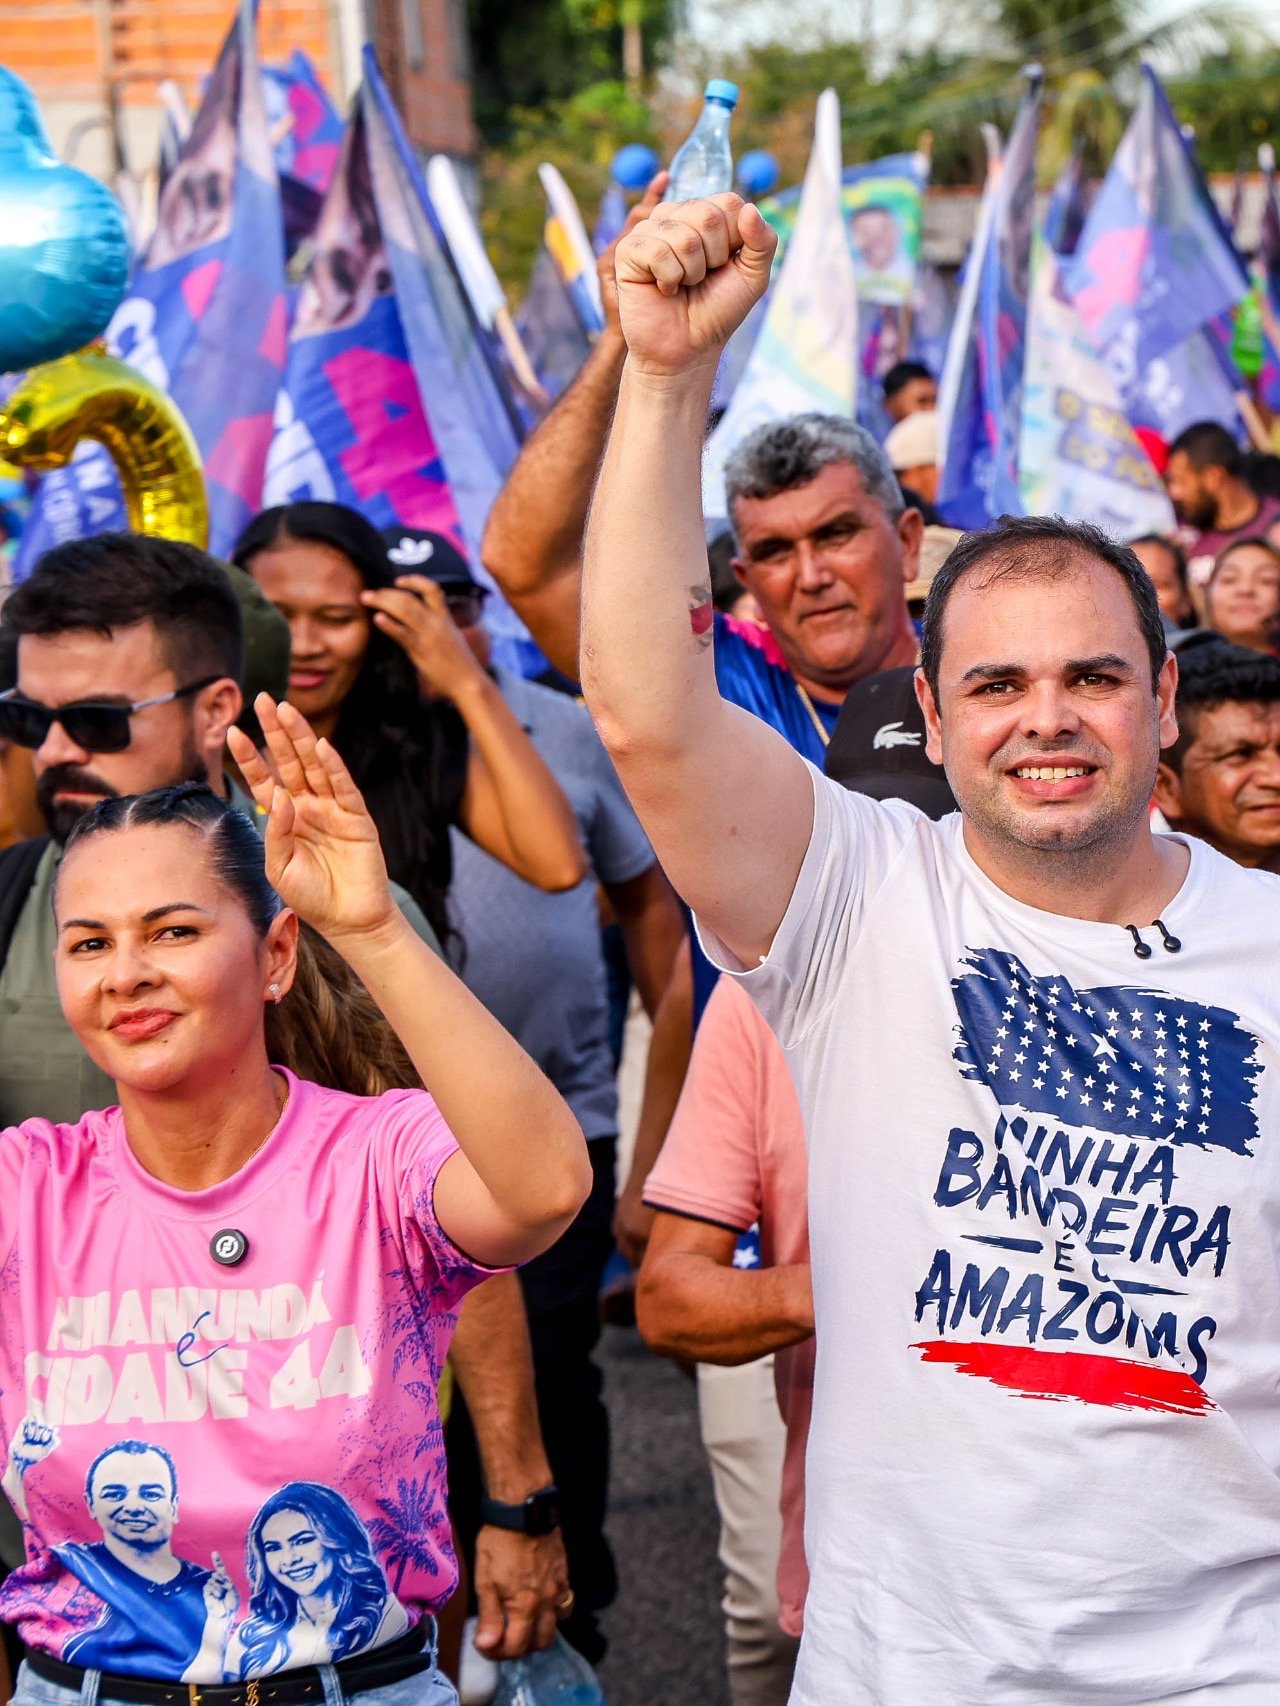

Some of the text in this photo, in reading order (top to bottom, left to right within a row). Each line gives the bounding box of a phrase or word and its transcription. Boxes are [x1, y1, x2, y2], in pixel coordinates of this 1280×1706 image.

[933, 1127, 1232, 1278] BANDEIRA
[24, 1323, 374, 1427] CIDADE 44
